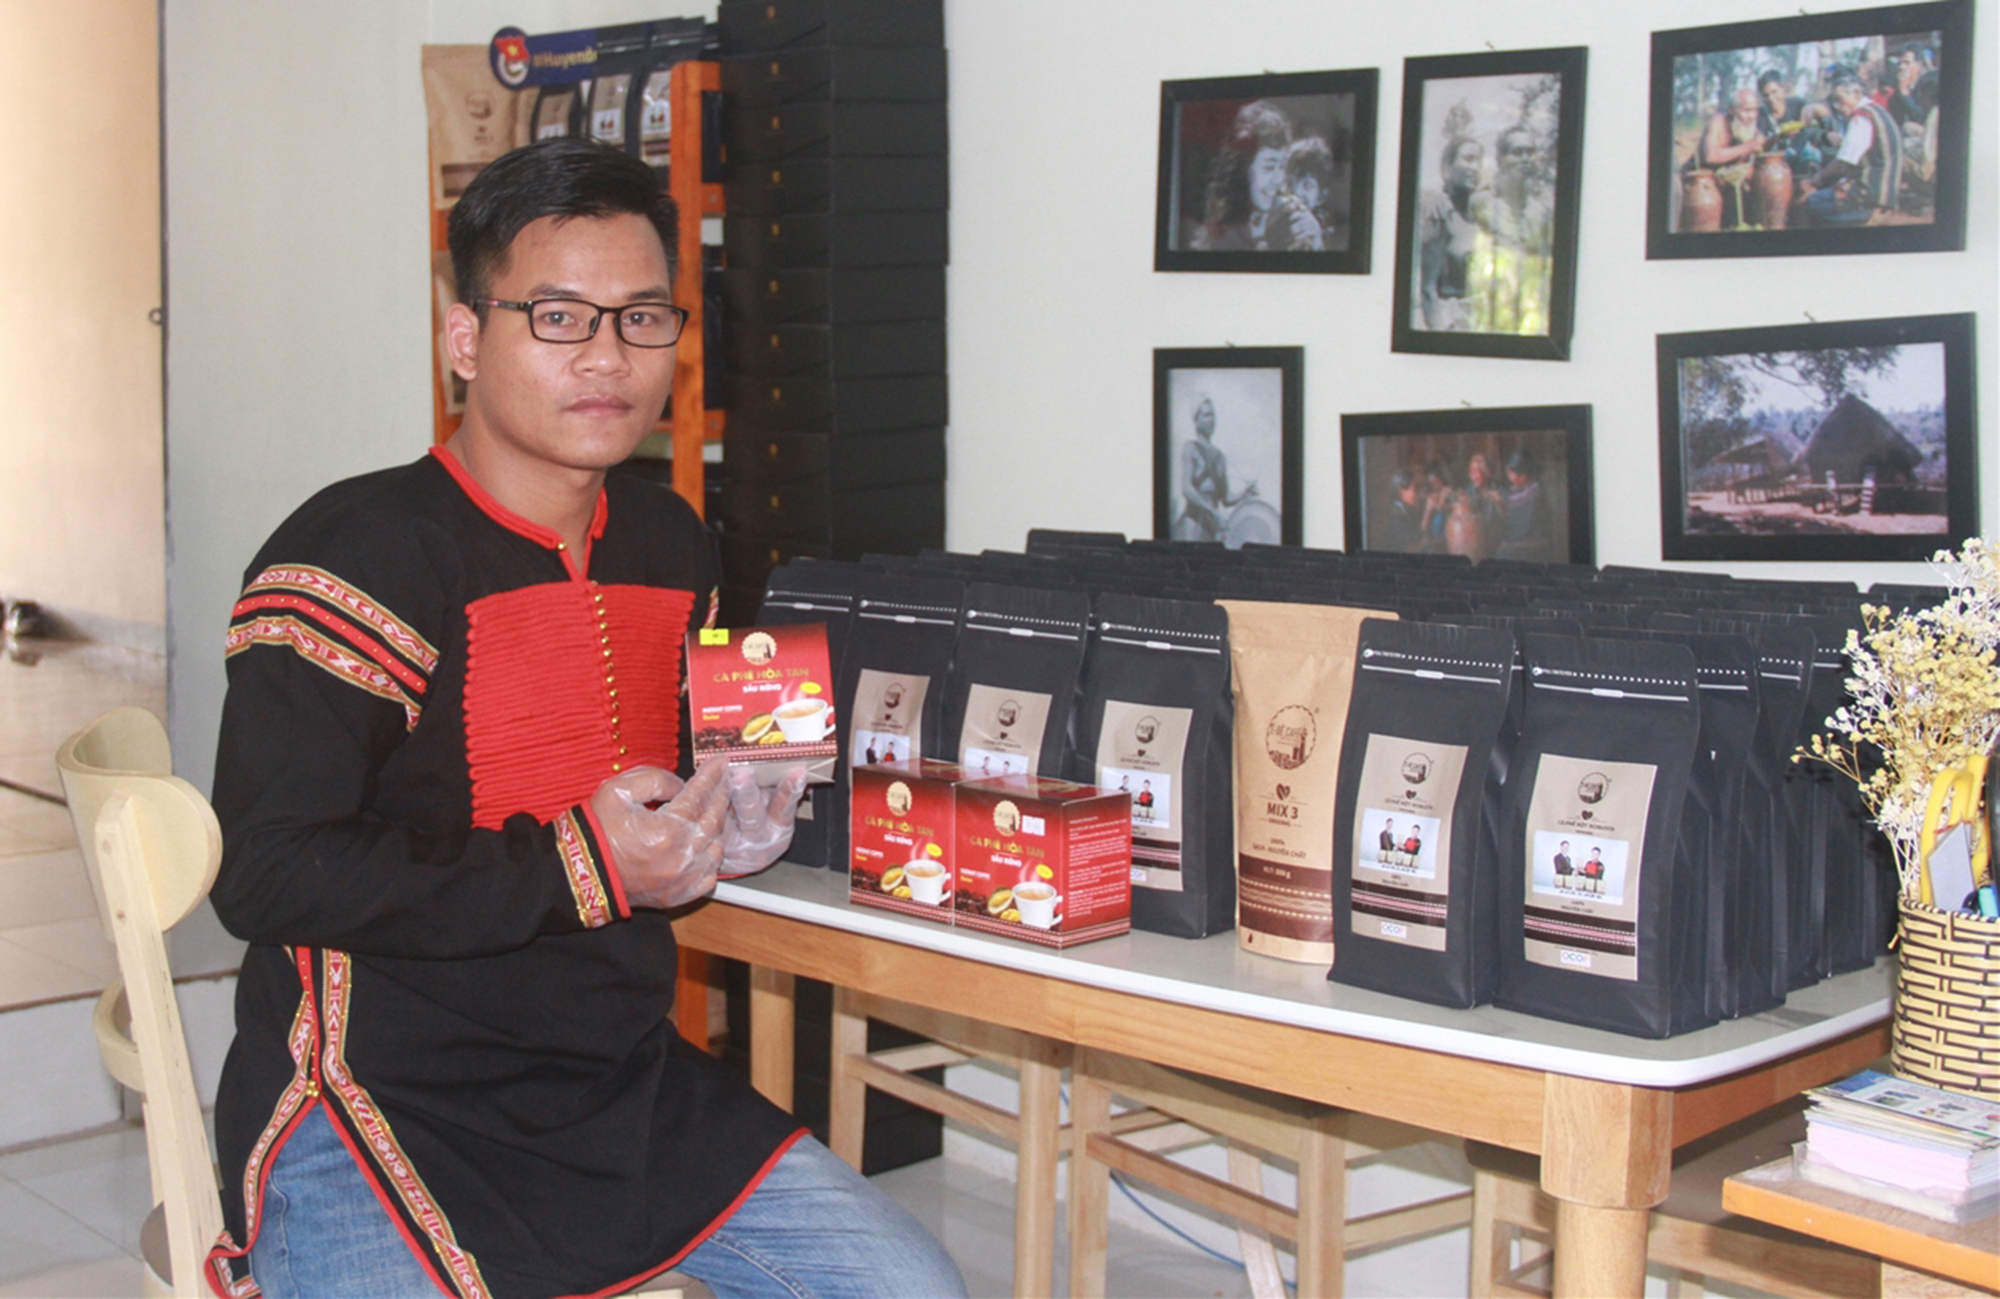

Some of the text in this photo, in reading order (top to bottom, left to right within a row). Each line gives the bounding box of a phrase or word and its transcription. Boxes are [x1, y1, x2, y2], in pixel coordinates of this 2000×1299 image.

[731, 669, 754, 682] PHÊ
[756, 668, 782, 680] HÒA
[786, 668, 810, 678] TAN
[1267, 802, 1298, 819] MIX 3
[917, 825, 934, 837] TAN
[984, 836, 1001, 850] PHÊ
[1003, 841, 1023, 855] HÒA
[1026, 846, 1045, 859] TAN
